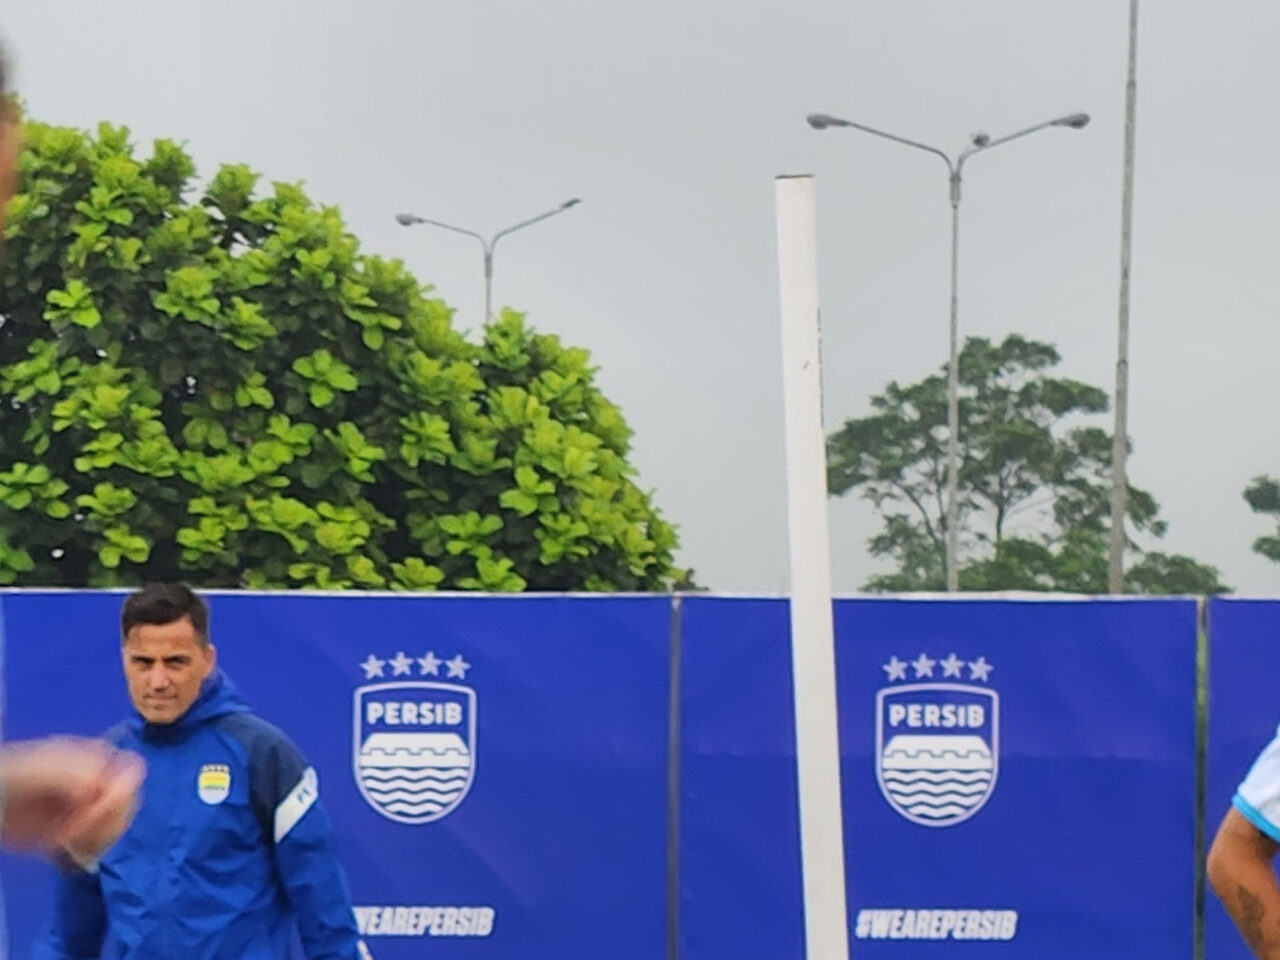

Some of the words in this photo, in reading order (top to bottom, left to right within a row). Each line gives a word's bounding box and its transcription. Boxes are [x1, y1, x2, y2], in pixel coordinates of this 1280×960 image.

[367, 702, 462, 725] PERSIB
[889, 704, 985, 728] PERSIB
[352, 906, 495, 936] WEAREPERSIB
[856, 909, 1017, 939] #WEAREPERSIB
